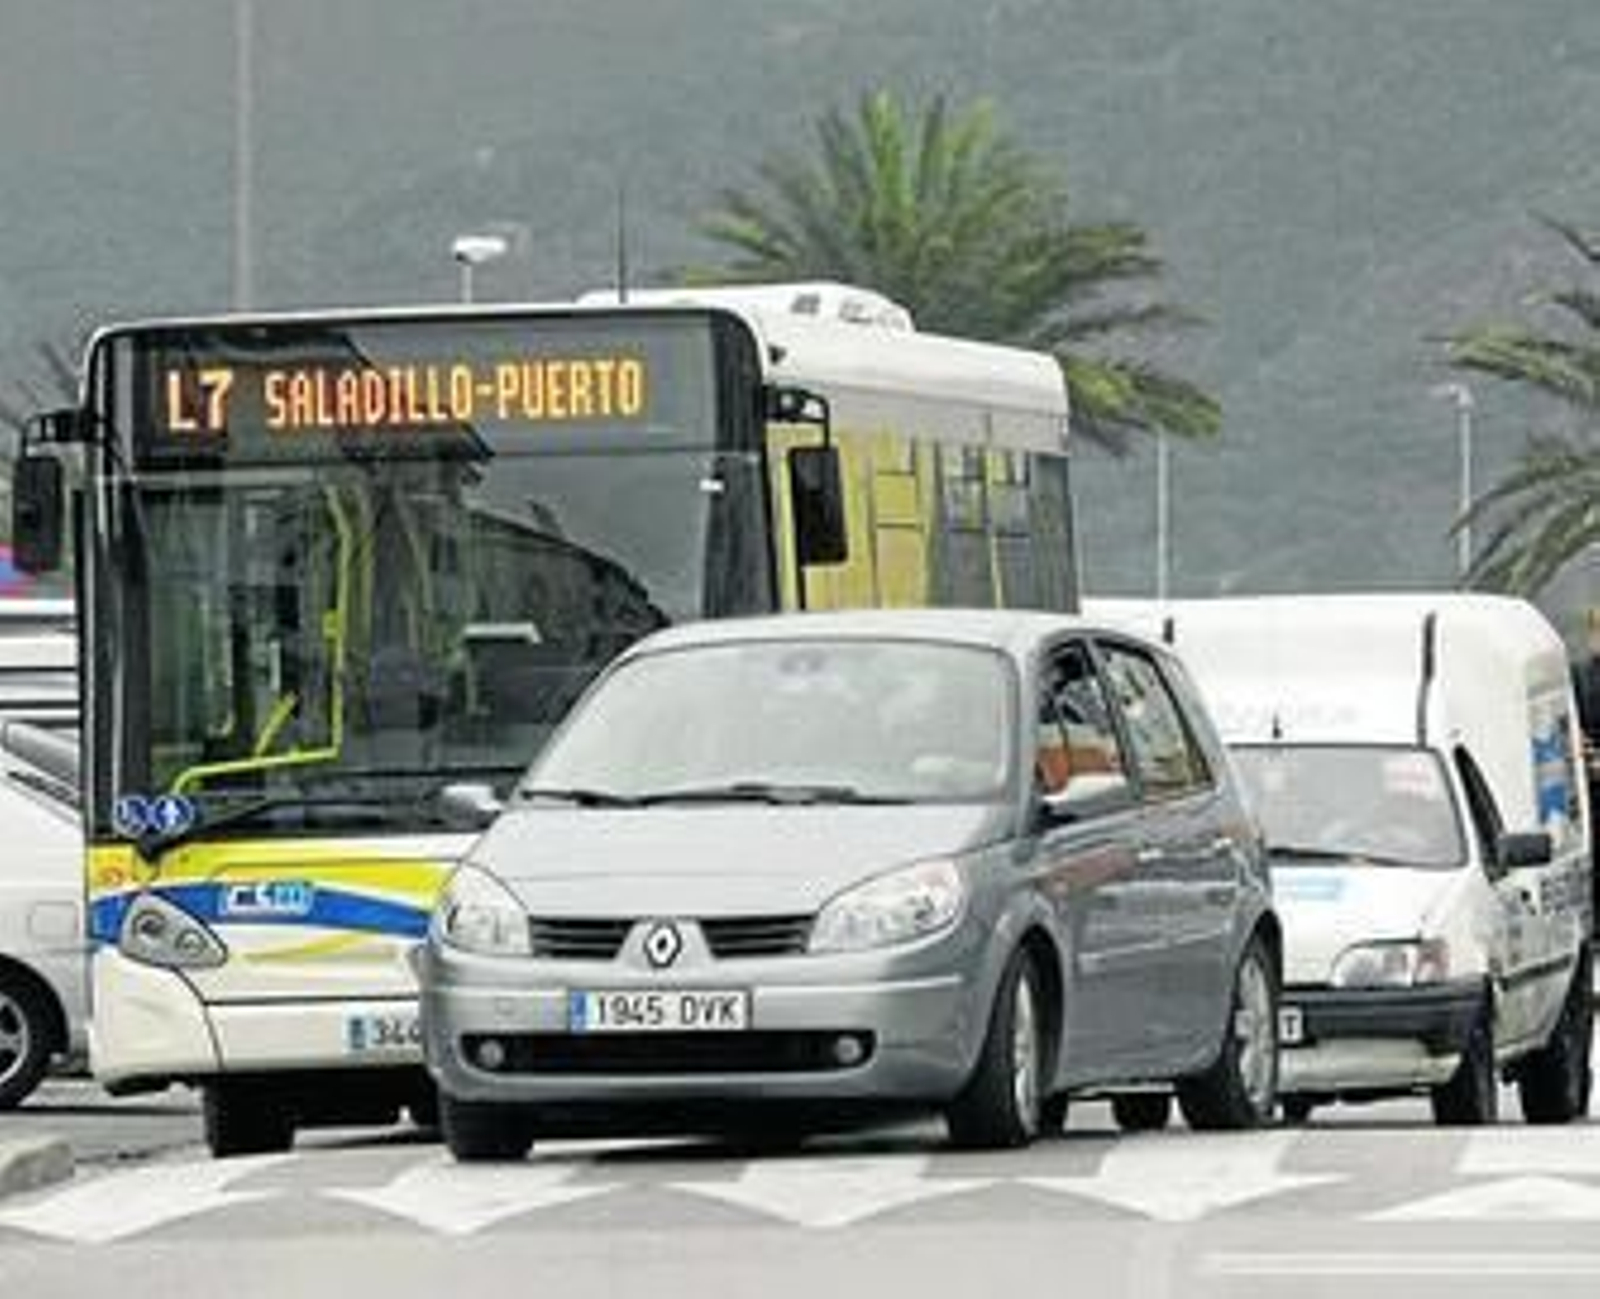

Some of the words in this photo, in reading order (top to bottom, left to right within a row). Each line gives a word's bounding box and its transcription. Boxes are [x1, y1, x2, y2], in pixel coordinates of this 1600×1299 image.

[167, 367, 234, 430] L7
[264, 359, 643, 428] SALADILLO-PUERTO
[597, 995, 664, 1026] 1945
[680, 995, 740, 1026] DVK
